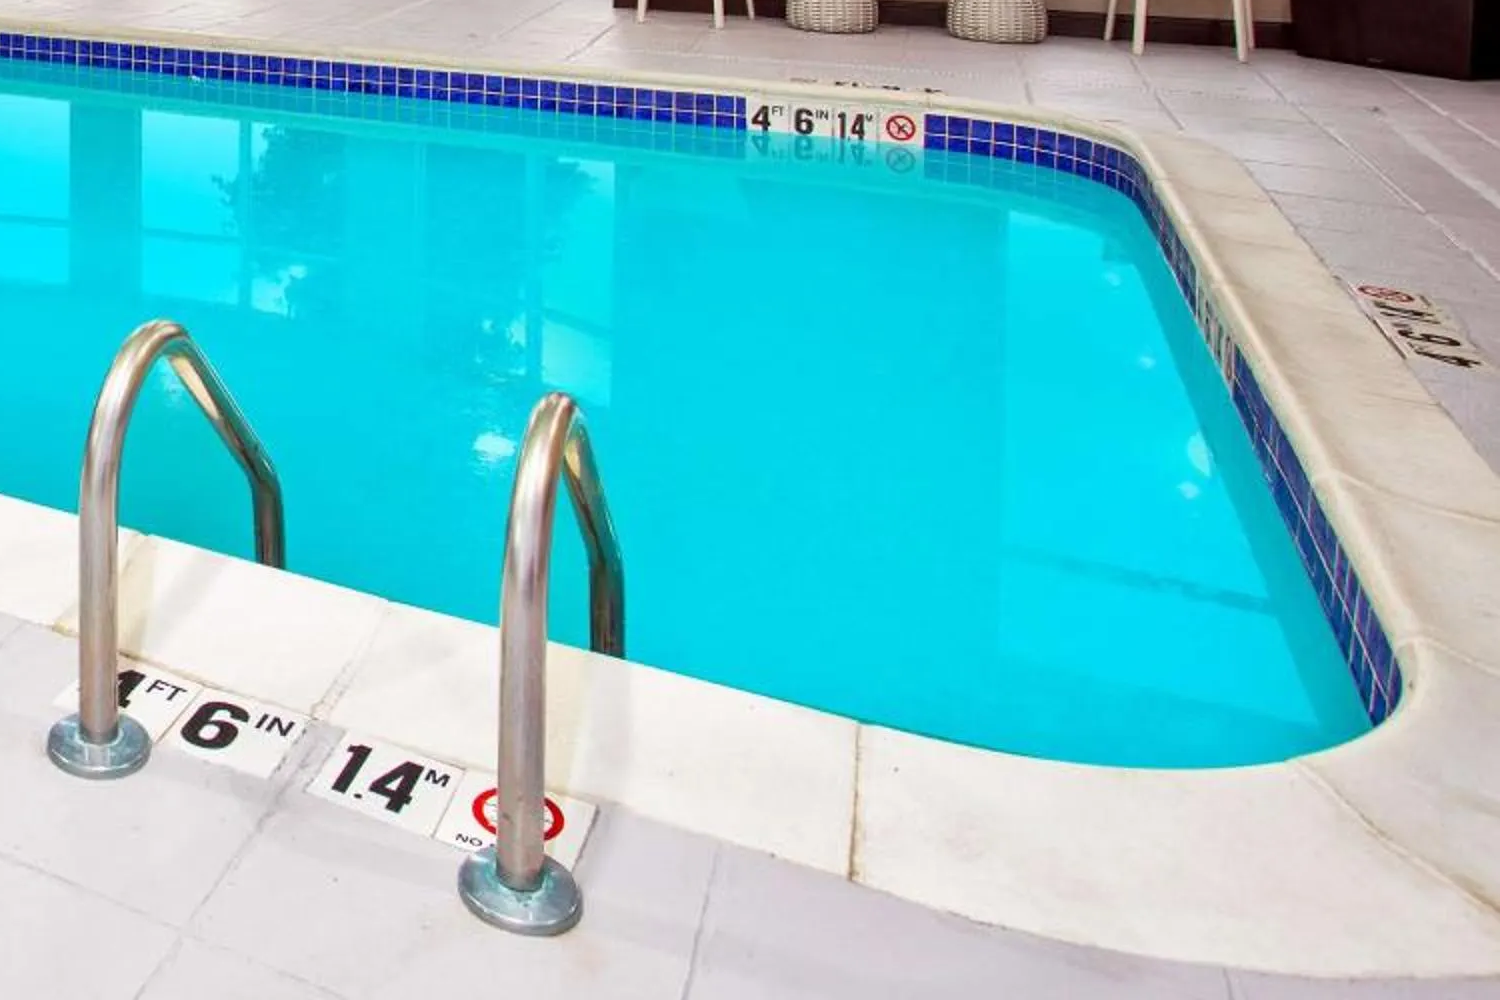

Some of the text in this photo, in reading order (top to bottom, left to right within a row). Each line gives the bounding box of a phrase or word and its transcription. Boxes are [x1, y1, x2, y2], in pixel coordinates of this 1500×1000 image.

[751, 105, 771, 131] 4
[794, 108, 814, 135] 6
[815, 109, 829, 121] IN
[145, 679, 188, 701] FT
[180, 701, 251, 750] 6
[255, 713, 296, 737] IN
[331, 744, 425, 814] 1.4
[424, 769, 451, 788] M
[455, 833, 483, 847] NO
